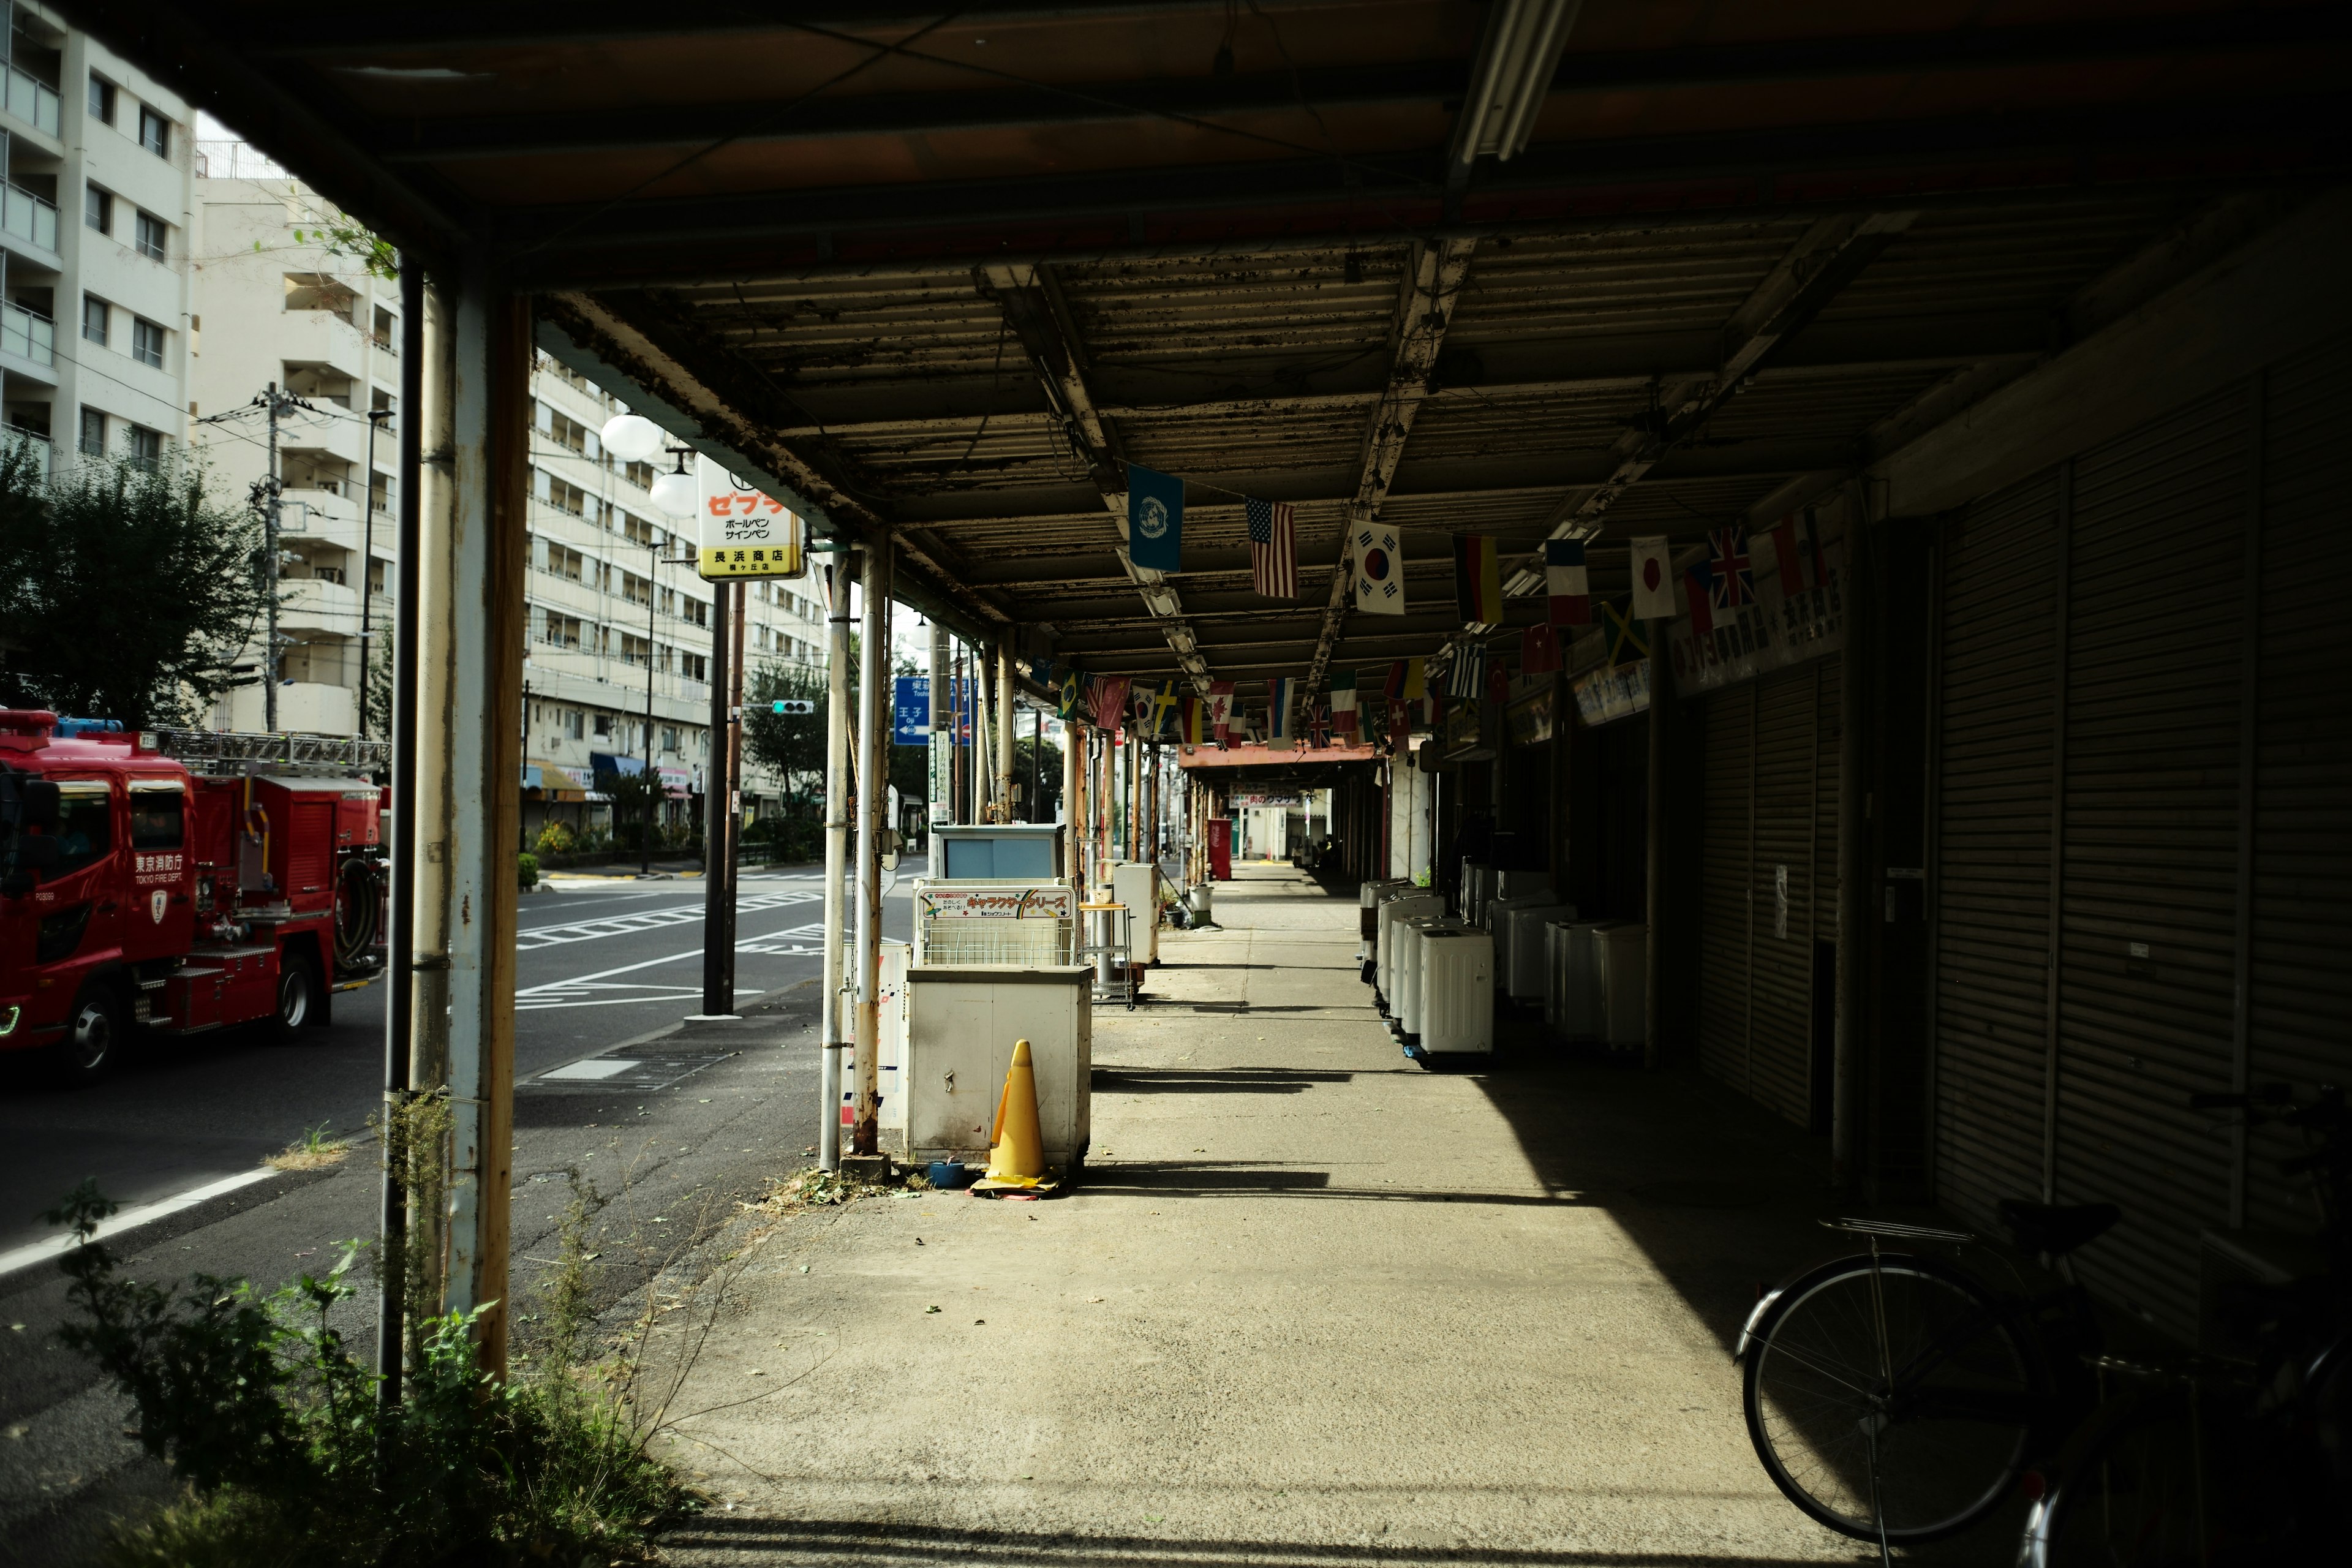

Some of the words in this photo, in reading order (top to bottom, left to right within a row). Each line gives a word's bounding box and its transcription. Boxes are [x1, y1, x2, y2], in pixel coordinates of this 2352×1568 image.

[725, 519, 769, 529] ボールペン
[725, 529, 769, 540] サインペン
[714, 549, 783, 562] 長浜商店
[899, 707, 922, 717] 王子
[136, 854, 183, 873] 東京消防庁
[135, 875, 154, 885] TOKYO
[155, 873, 167, 883] FIRE
[168, 872, 183, 882] DEPT.
[967, 896, 1067, 909] キャラクターシリーズ
